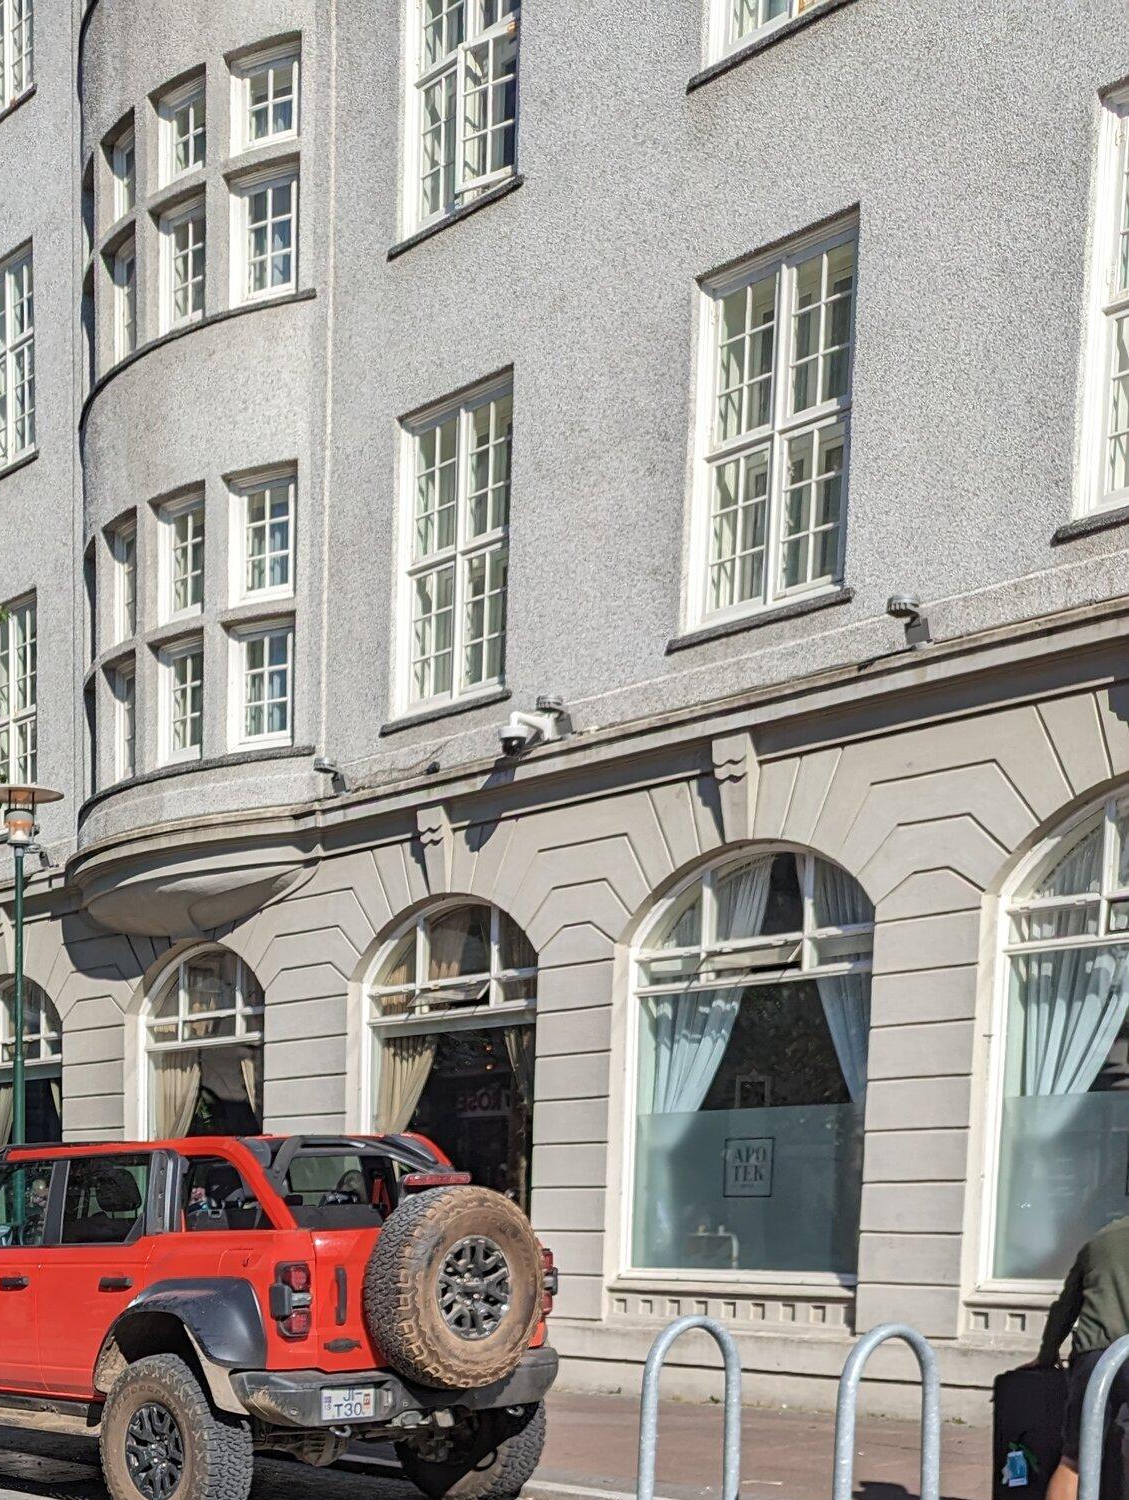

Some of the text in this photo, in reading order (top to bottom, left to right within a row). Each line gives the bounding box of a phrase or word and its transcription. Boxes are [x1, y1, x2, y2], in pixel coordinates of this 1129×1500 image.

[734, 1146, 766, 1162] APO
[734, 1165, 764, 1181] TEK
[333, 1402, 362, 1417] T30
